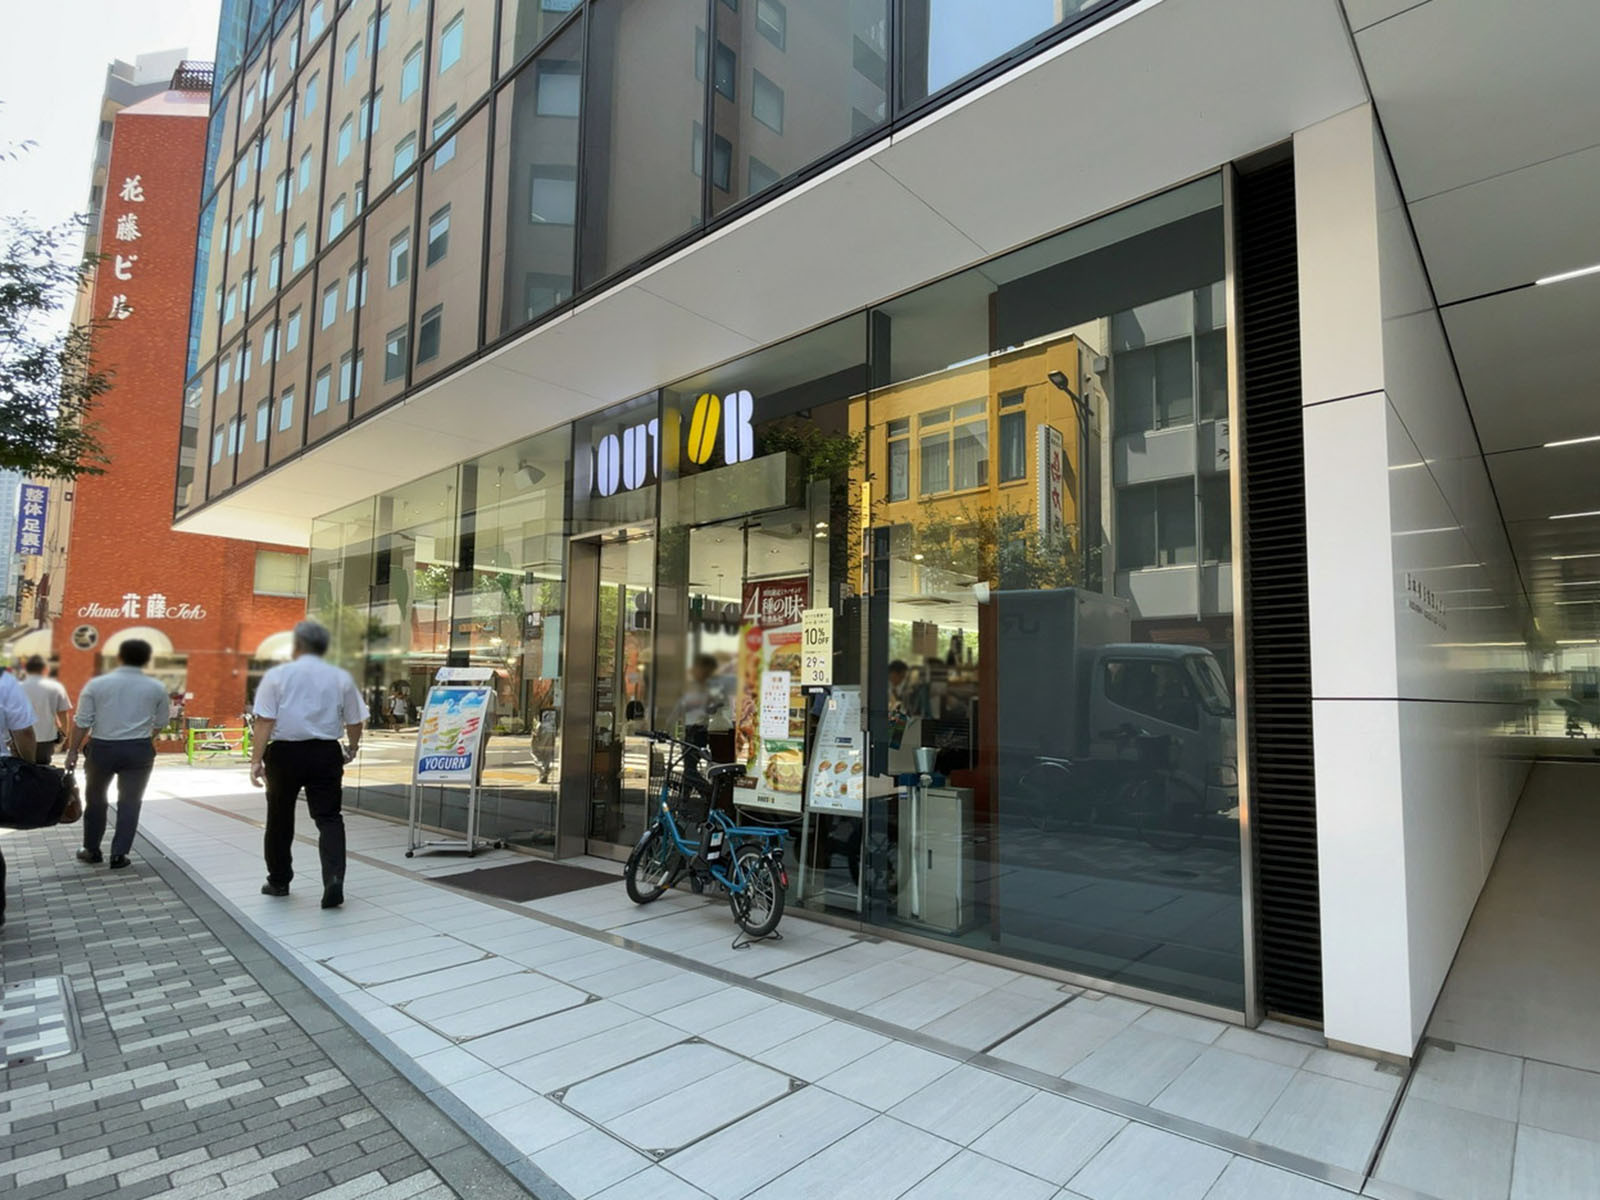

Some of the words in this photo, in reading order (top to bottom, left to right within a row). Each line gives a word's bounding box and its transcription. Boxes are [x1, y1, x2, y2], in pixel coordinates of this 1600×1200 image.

[77, 602, 121, 619] Hana
[121, 592, 167, 619] 花藤
[424, 756, 467, 770] YOGURN
